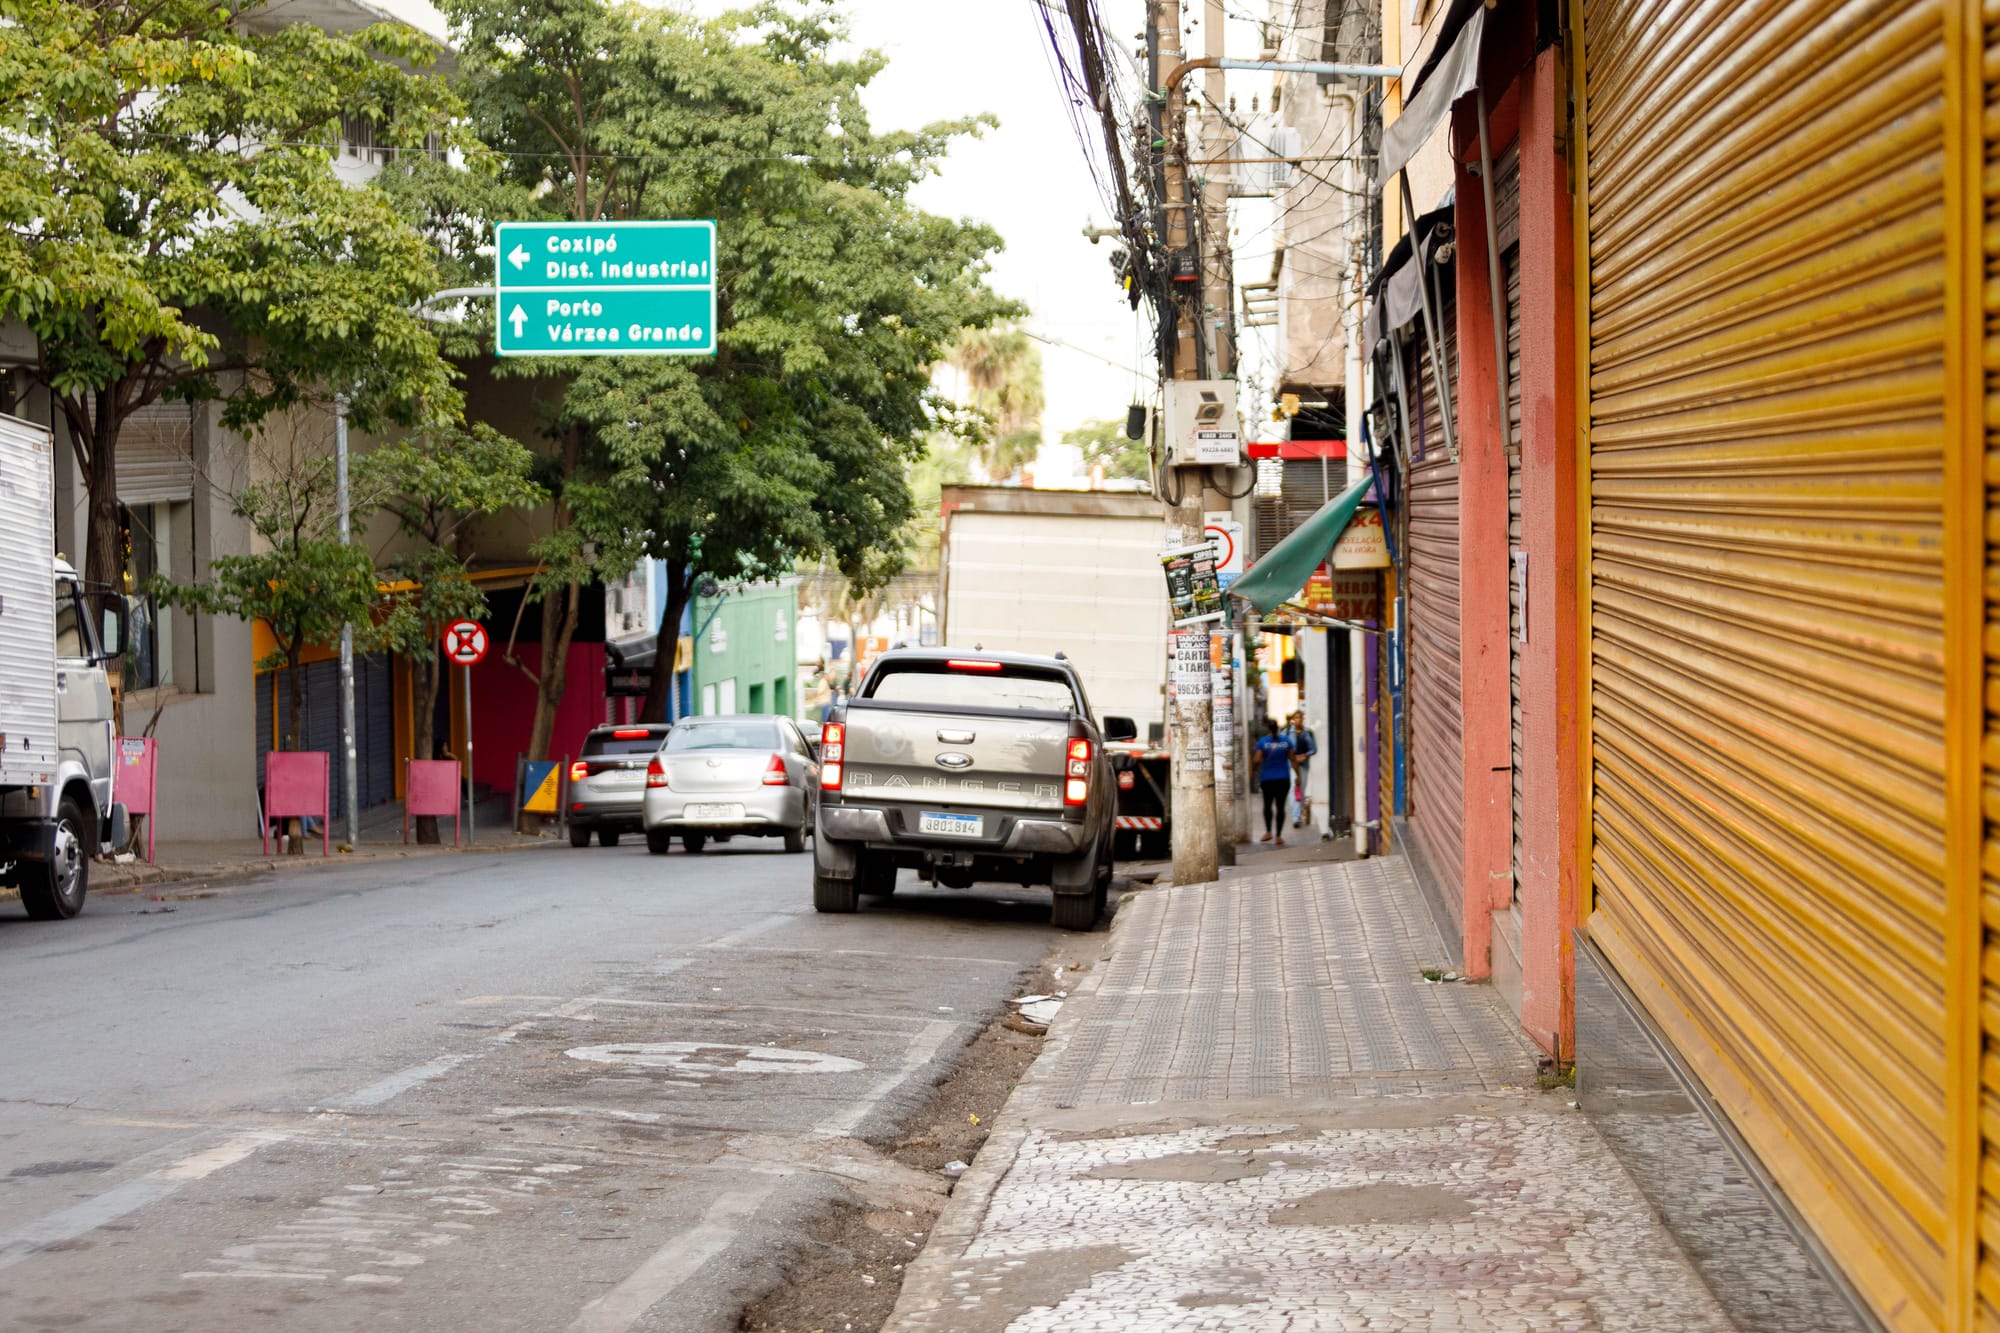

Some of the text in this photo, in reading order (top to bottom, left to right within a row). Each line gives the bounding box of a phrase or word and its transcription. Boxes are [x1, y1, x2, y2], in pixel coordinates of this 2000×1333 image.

[546, 233, 617, 255] Coxipó
[546, 260, 708, 279] Dist. Industrial
[546, 299, 603, 317] Porto
[547, 323, 703, 342] Várzea Grande
[849, 772, 1058, 798] RANGER
